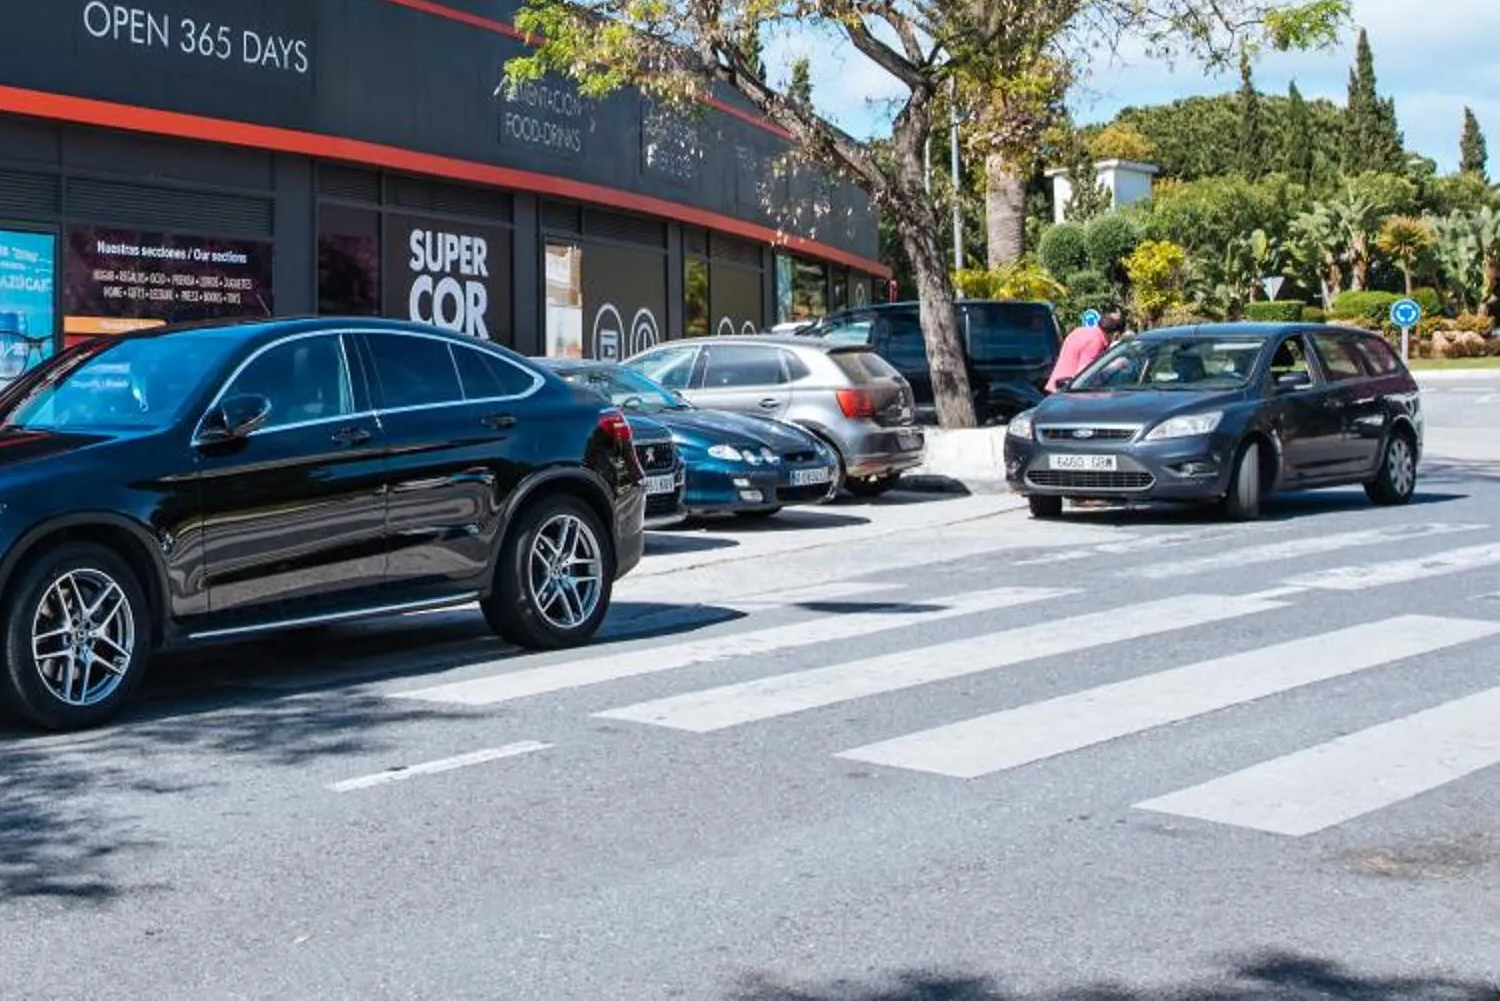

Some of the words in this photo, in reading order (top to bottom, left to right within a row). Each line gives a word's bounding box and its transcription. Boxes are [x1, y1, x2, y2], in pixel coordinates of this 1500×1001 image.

[83, 0, 169, 48] OPEN
[180, 18, 231, 60] 365
[243, 30, 308, 73] DAYS
[193, 248, 210, 262] Our
[409, 228, 489, 277] SUPER
[409, 274, 490, 340] COR
